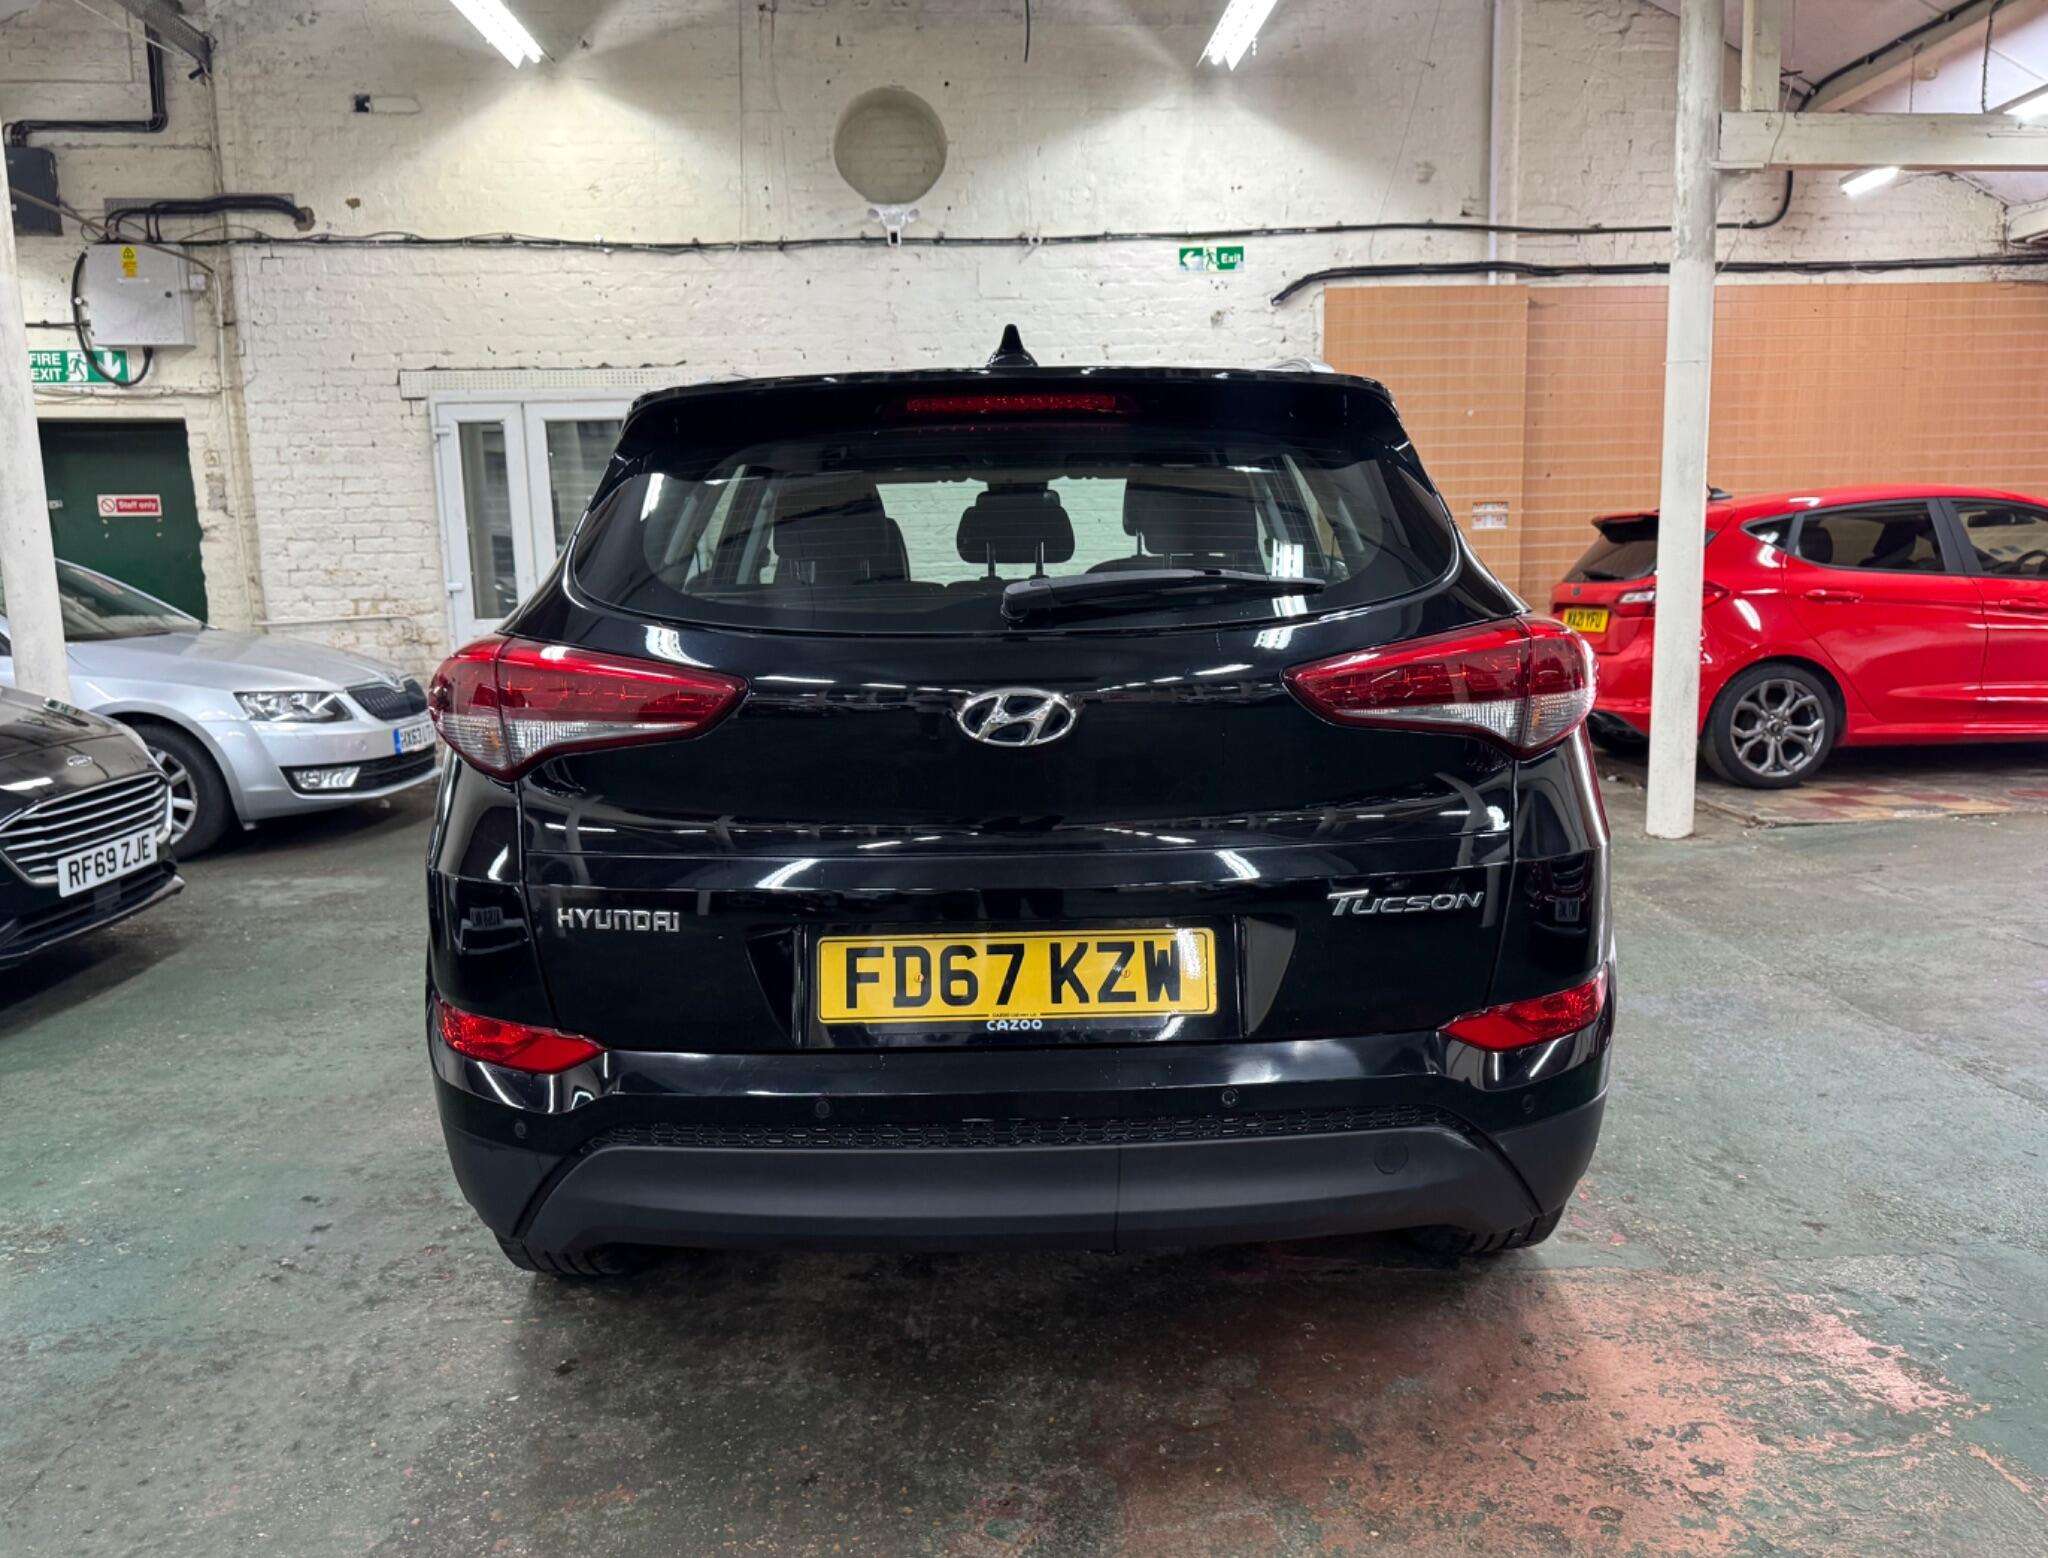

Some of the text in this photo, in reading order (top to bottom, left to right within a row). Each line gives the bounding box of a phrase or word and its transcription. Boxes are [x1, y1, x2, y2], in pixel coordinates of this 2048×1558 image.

[29, 353, 61, 366] FIRE
[31, 368, 62, 381] EXIT
[68, 834, 151, 888] RF69 ZJE
[557, 907, 680, 933] HYUNDAI
[846, 940, 1182, 1009] FD67 KZW
[986, 1019, 1042, 1032] CAZOO
